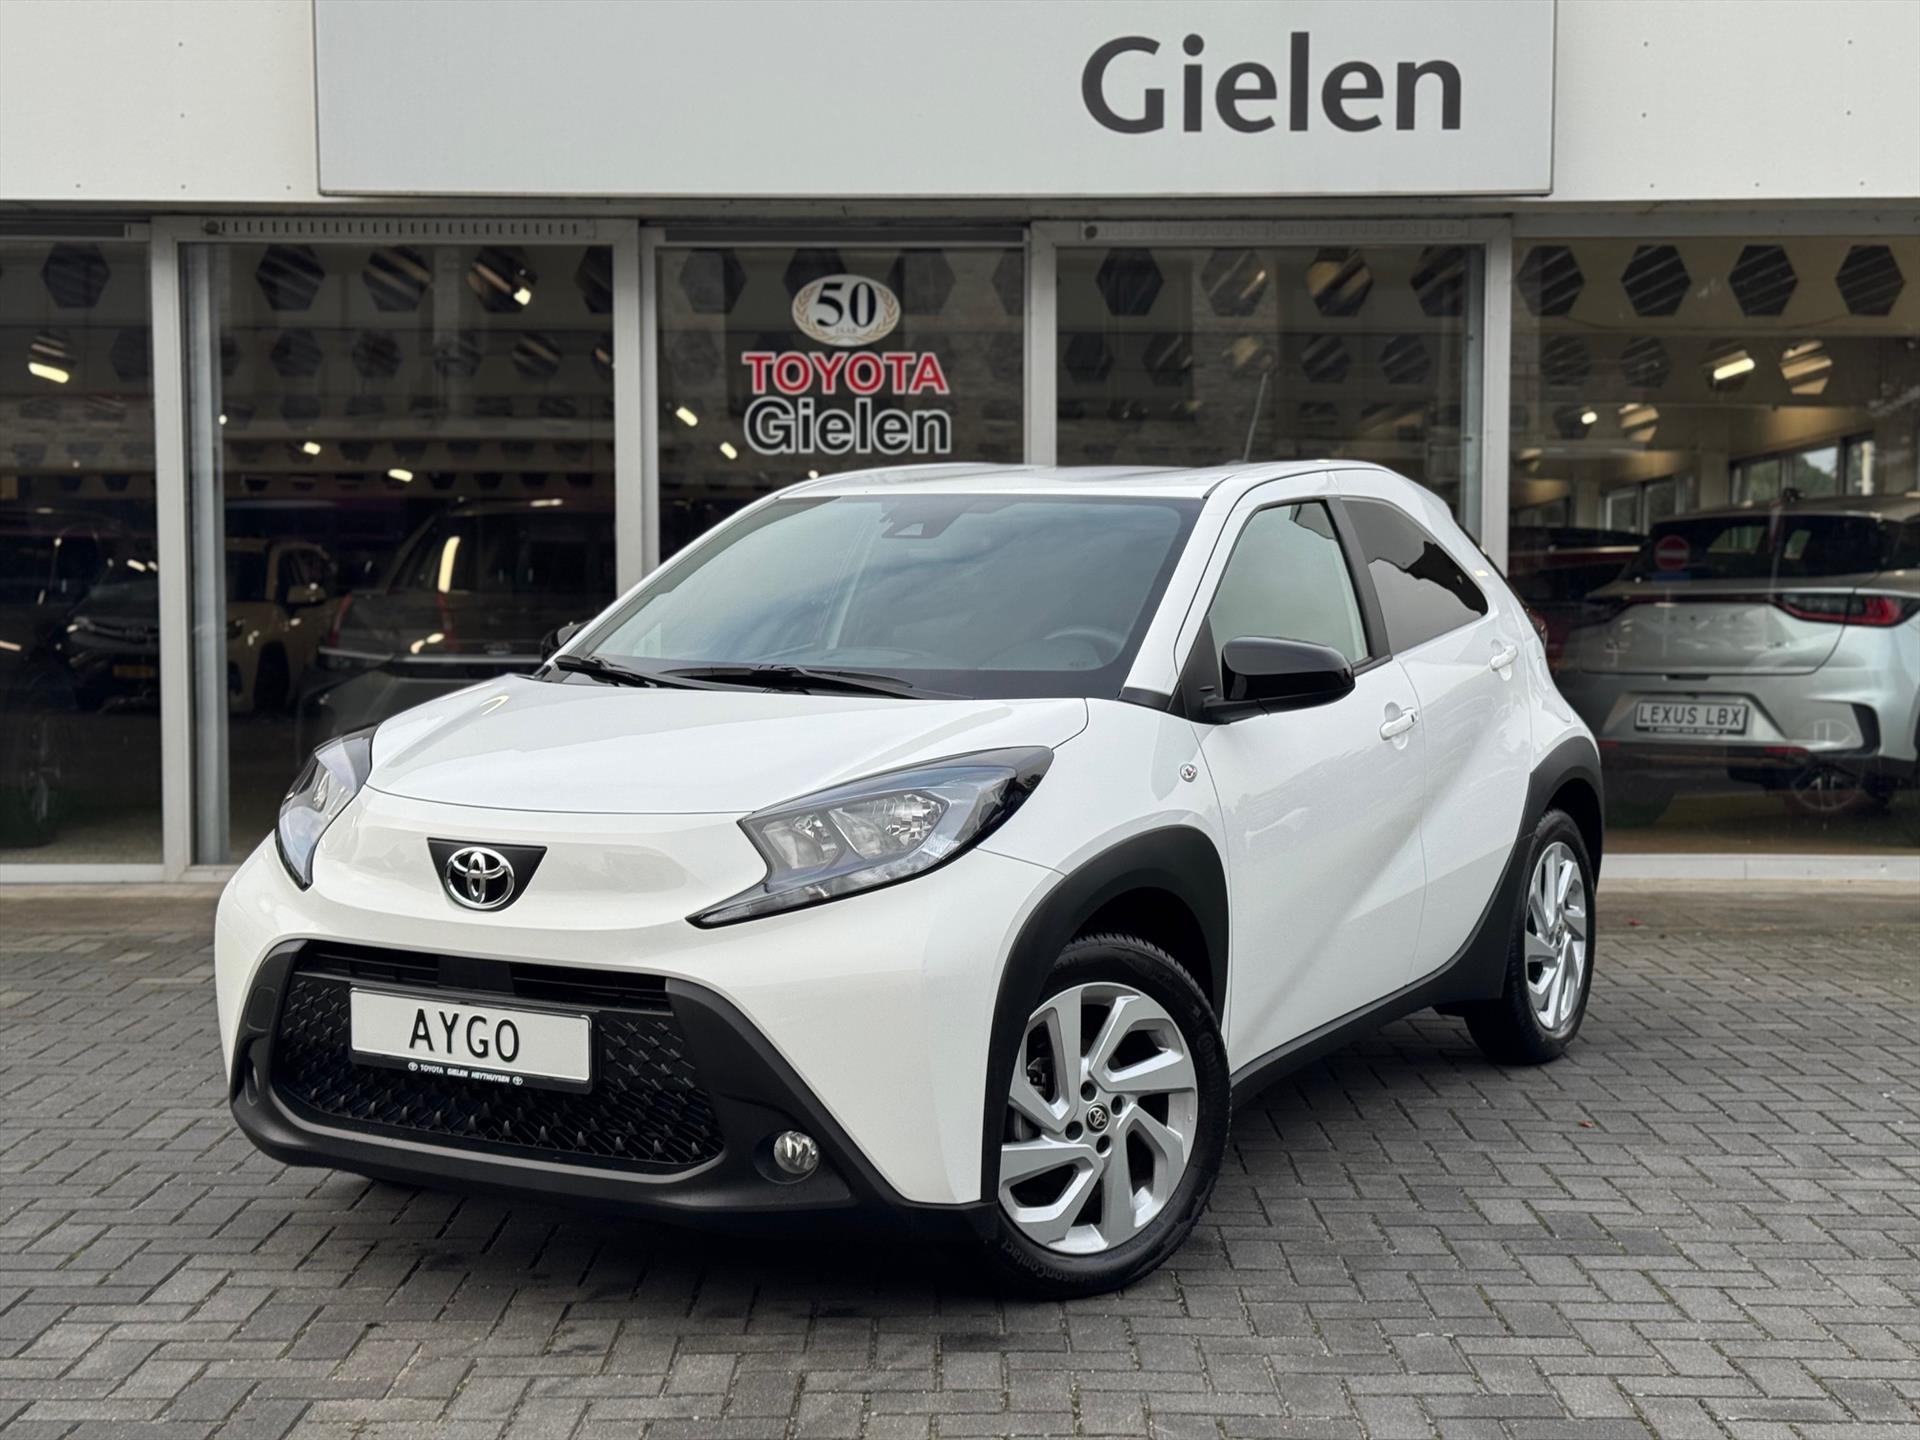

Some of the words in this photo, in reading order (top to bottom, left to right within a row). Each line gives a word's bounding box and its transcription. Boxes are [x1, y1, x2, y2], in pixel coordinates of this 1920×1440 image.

[1082, 31, 1461, 134] Gielen
[815, 281, 877, 328] 50
[742, 352, 949, 394] TOYOTA
[744, 396, 951, 455] Gielen
[1639, 705, 1698, 725] LEXUS
[1705, 707, 1742, 726] LBX
[408, 1008, 520, 1063] AYGO
[420, 1064, 444, 1075] TOYOTA
[447, 1067, 469, 1078] GIELEN
